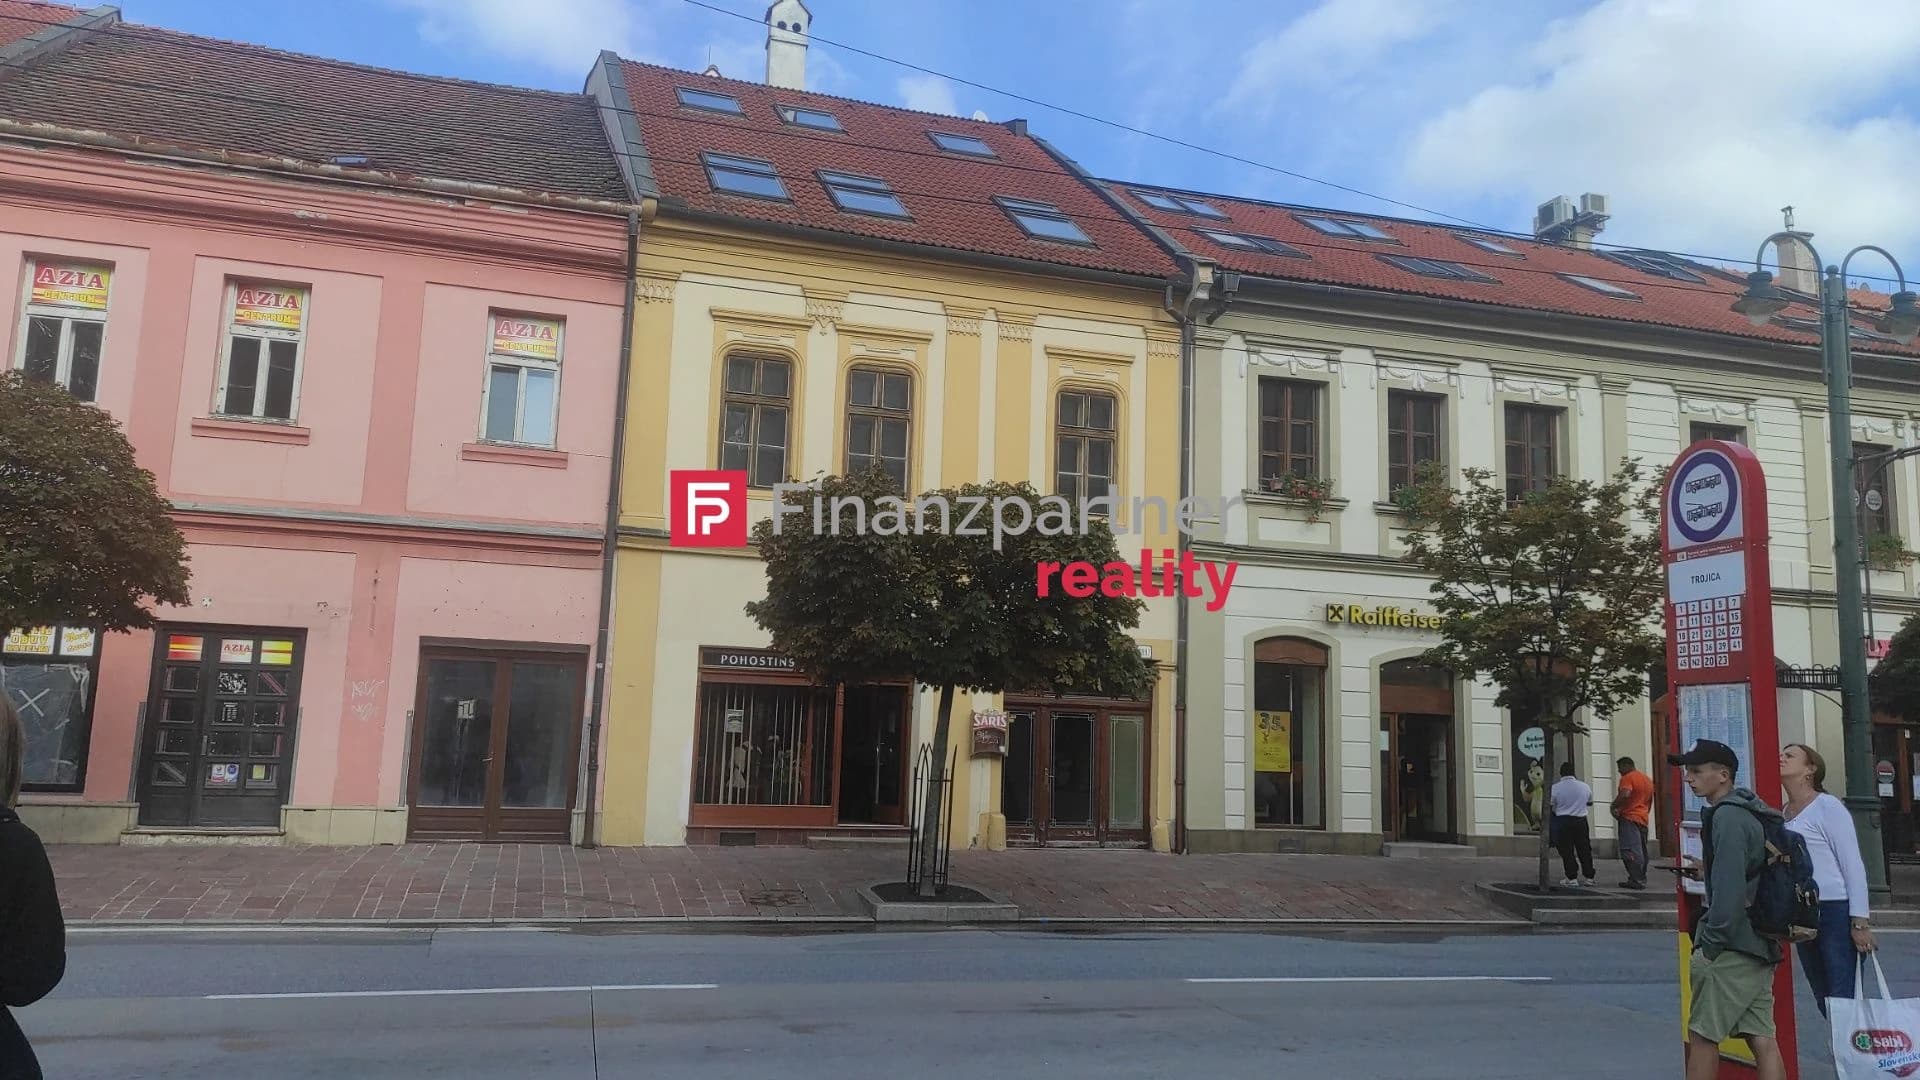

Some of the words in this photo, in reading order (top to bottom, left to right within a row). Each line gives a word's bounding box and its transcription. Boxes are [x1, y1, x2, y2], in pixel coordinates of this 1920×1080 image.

[37, 267, 105, 290] AZIA
[43, 290, 97, 303] CENTRUM
[237, 289, 302, 311] AZIA
[243, 310, 292, 324] CENTRUM
[497, 320, 556, 341] AZIA
[1690, 572, 1721, 585] TROJICA
[1349, 604, 1447, 629] Raiffeise
[1691, 617, 1698, 625] 11
[1704, 616, 1711, 624] 12
[1731, 612, 1739, 621] 15
[1691, 631, 1698, 639] 21
[1704, 630, 1712, 638] 22
[1718, 628, 1725, 636] 24
[1731, 626, 1739, 635] 27
[223, 644, 251, 652] AZIA
[1705, 643, 1712, 652] 36
[1718, 642, 1726, 650] 39
[1704, 657, 1714, 666] 20
[1718, 656, 1728, 665] 23
